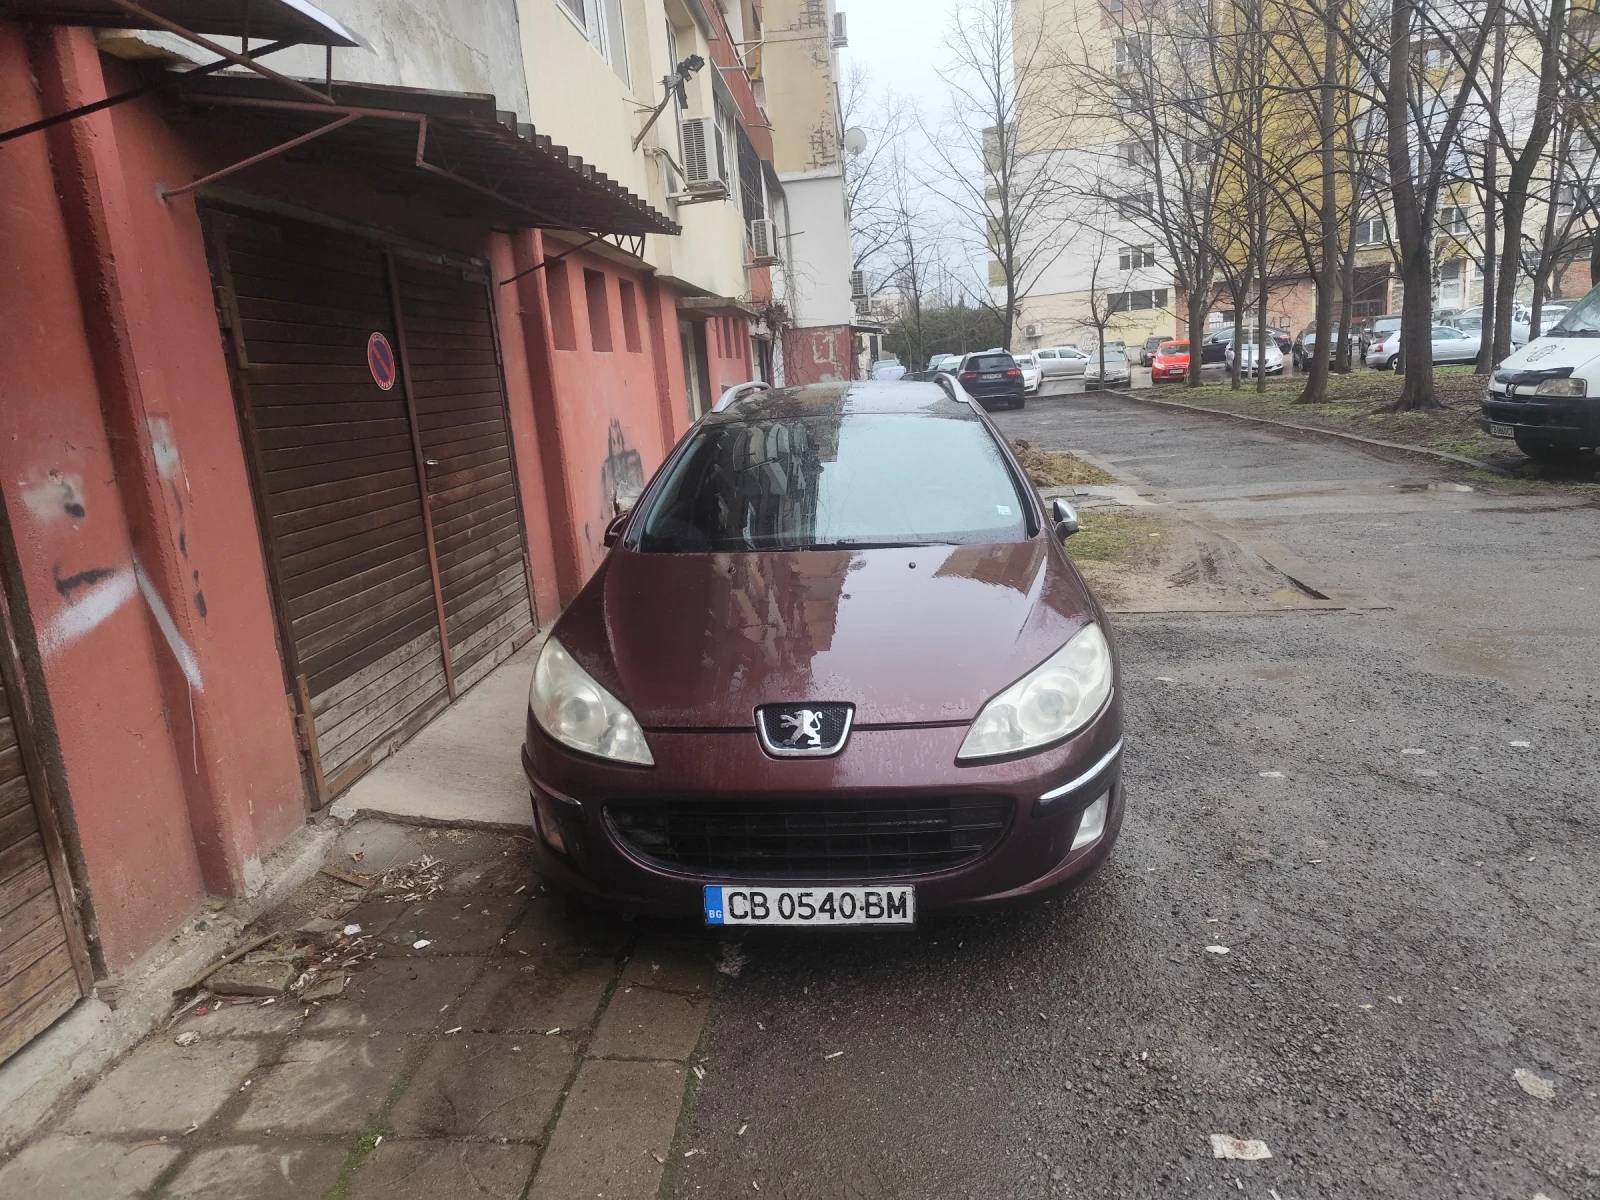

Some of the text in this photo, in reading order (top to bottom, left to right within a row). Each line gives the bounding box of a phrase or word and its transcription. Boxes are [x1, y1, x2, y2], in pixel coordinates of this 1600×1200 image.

[708, 910, 722, 919] BG
[728, 891, 907, 920] CB 0540 BM
